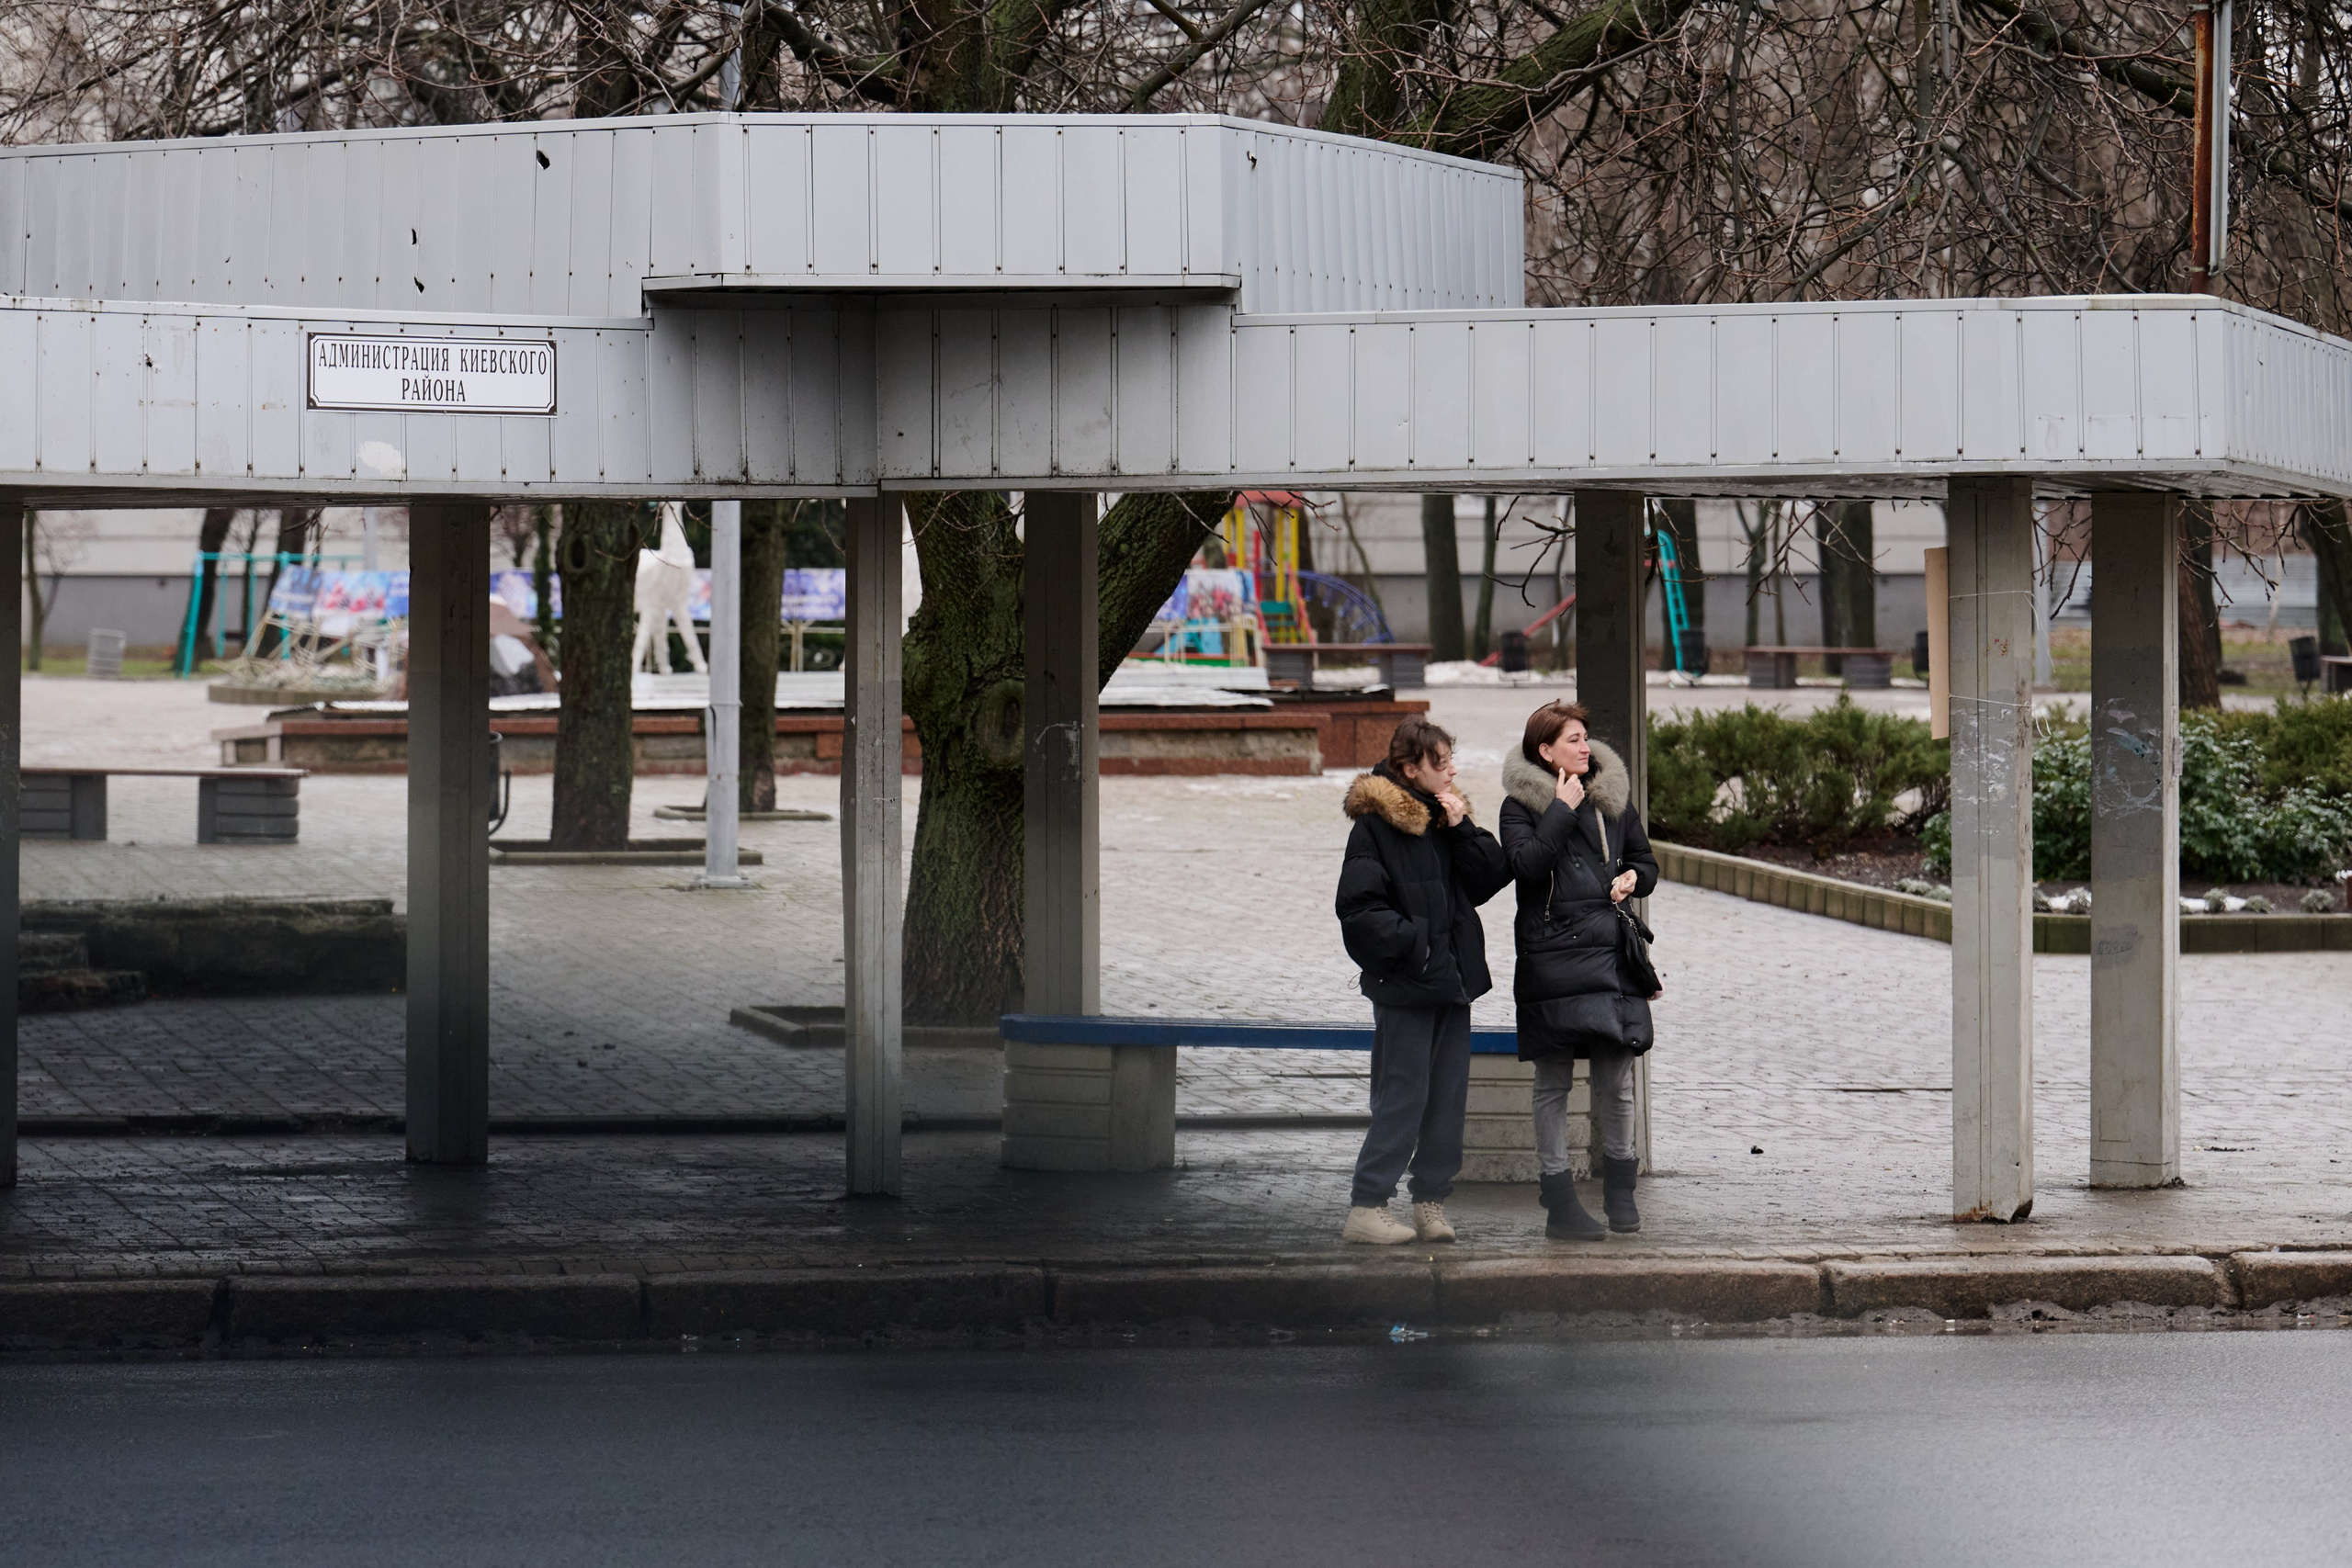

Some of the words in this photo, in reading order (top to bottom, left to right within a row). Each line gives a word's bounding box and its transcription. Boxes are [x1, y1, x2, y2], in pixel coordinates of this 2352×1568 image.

[318, 343, 450, 372] АДМИНИСТРАЦИЯ
[459, 348, 548, 376] КИЕВСКОГО
[401, 374, 467, 402] РАЙОНА
